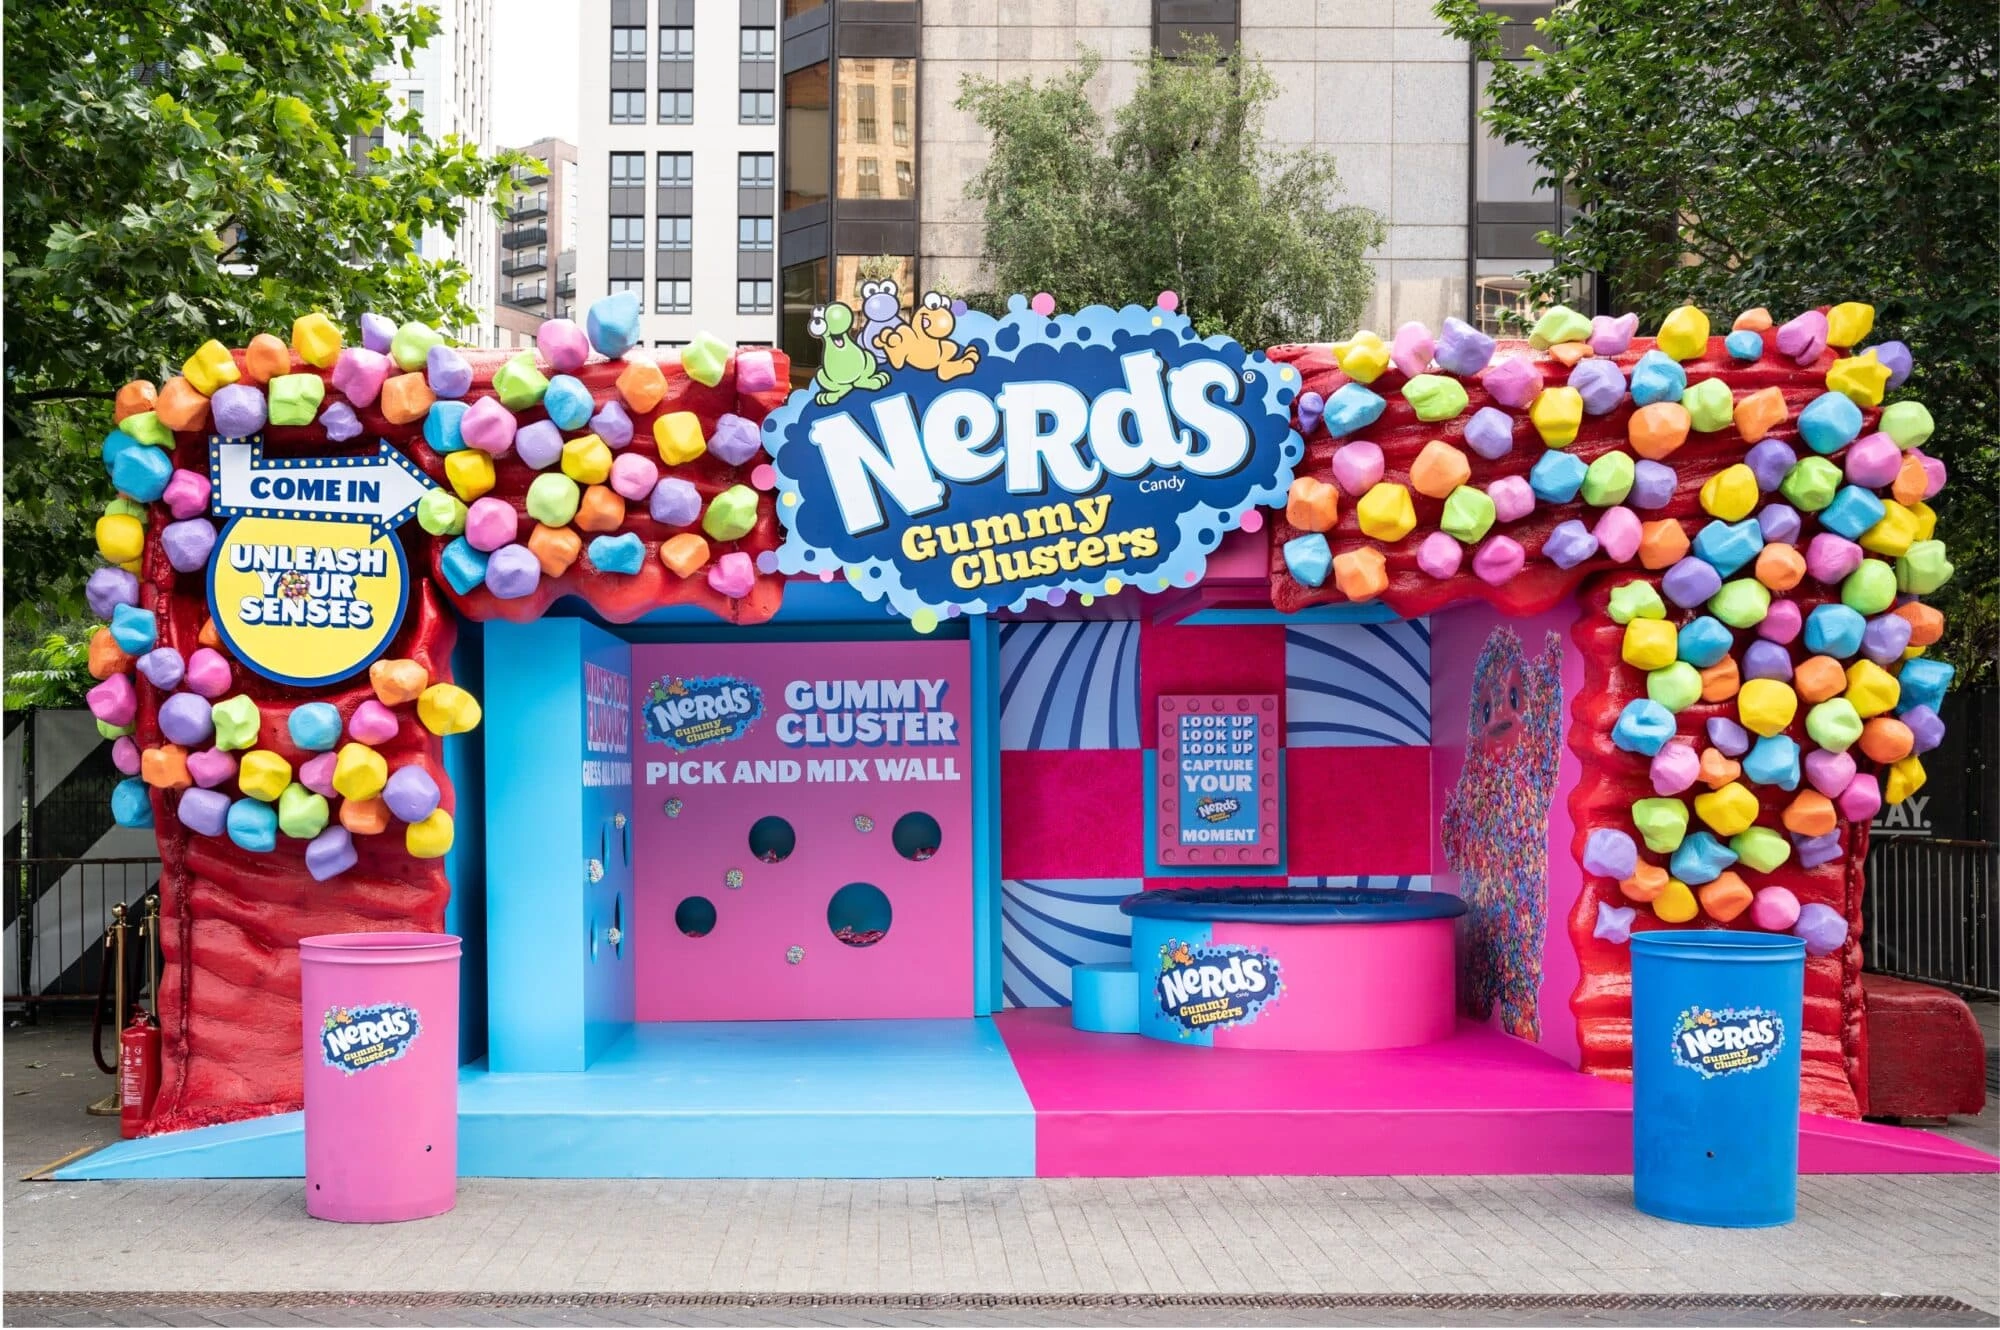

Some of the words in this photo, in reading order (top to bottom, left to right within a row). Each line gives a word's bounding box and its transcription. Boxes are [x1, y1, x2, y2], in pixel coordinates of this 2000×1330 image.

[250, 477, 341, 501] COME
[348, 480, 380, 503] IN
[1139, 475, 1186, 494] Candy
[902, 493, 1112, 562] Gummy
[230, 544, 386, 576] UNLEASH
[951, 526, 1159, 590] Clusters
[238, 597, 374, 628] SENSES
[784, 679, 948, 712] GUMMY
[675, 719, 722, 737] Gummy
[776, 712, 959, 746] CLUSTER
[1182, 717, 1227, 729] LOOK
[1232, 717, 1253, 729] UP
[1182, 730, 1227, 742] LOOK
[1232, 730, 1253, 742] UP
[1182, 743, 1227, 755] LOOK
[1232, 743, 1253, 755] UP
[646, 761, 726, 784] PICK
[732, 760, 801, 783] AND
[807, 759, 869, 782] MIX
[874, 758, 960, 781] WALL
[1182, 759, 1253, 771] CAPTURE
[1184, 775, 1252, 792] YOUR
[1871, 796, 1931, 828] AY.
[1182, 829, 1255, 842] MOMENT
[1180, 997, 1229, 1016] Gummy
[1191, 1007, 1243, 1024] Clusters
